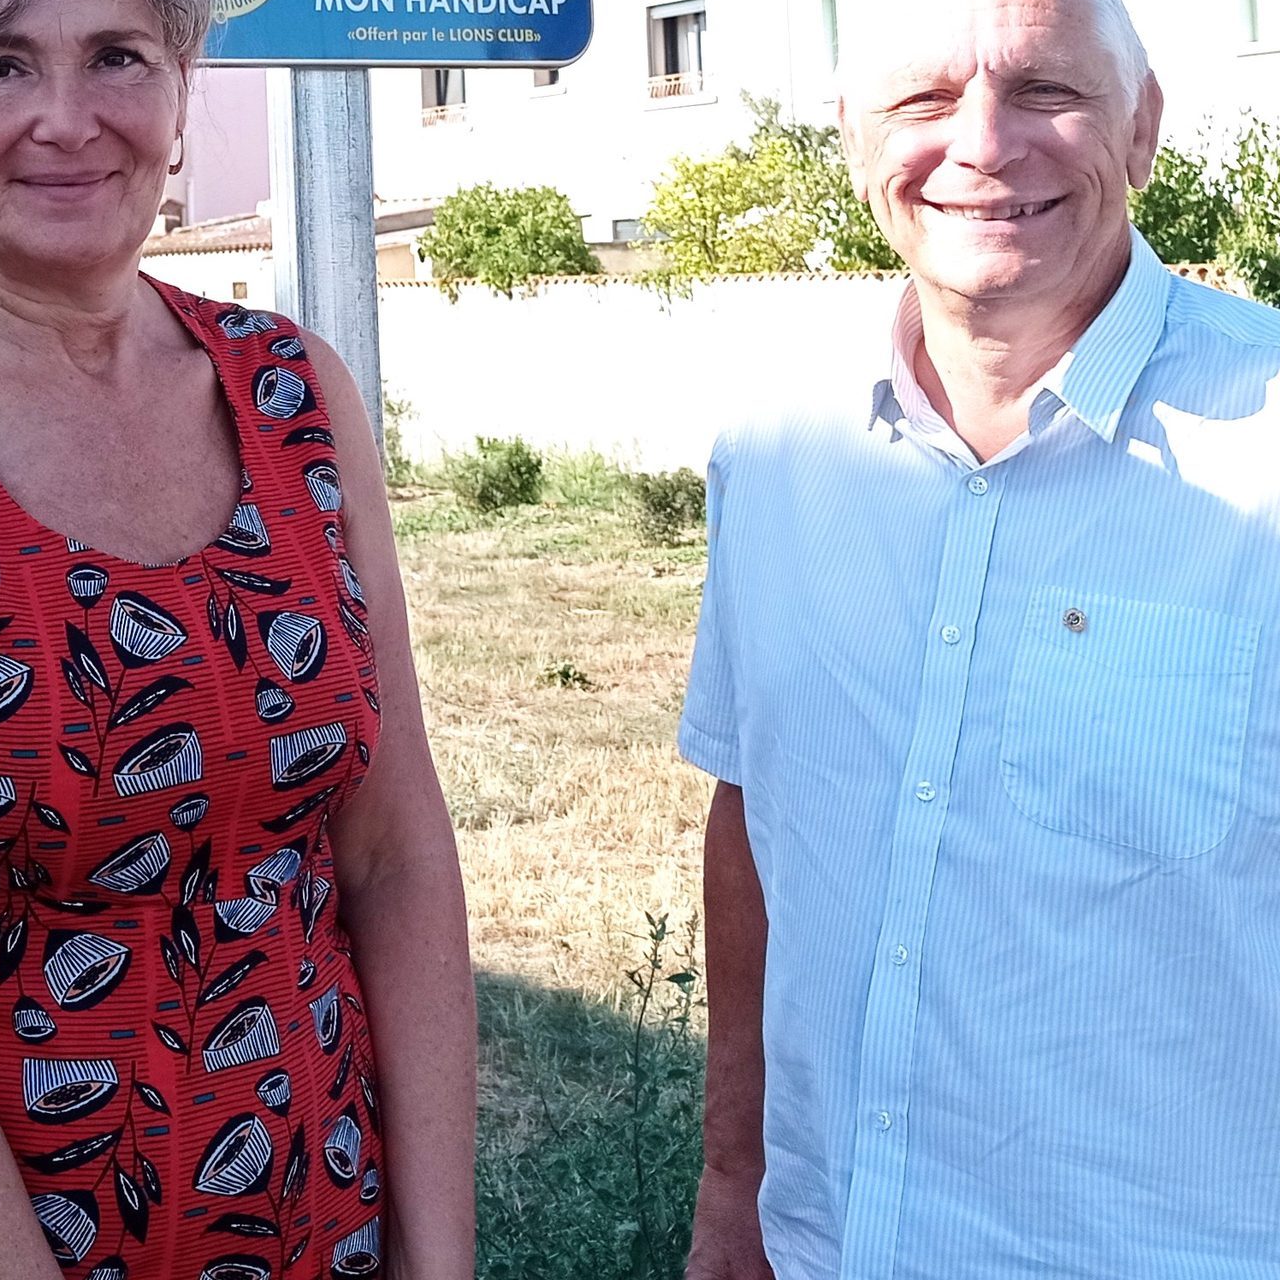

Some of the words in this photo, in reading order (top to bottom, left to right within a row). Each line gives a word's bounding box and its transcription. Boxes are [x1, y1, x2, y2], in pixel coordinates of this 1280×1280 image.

[347, 27, 398, 42] «Offert
[402, 29, 427, 44] par
[432, 27, 445, 42] le
[449, 28, 494, 43] LIONS
[497, 29, 541, 43] CLUB»
